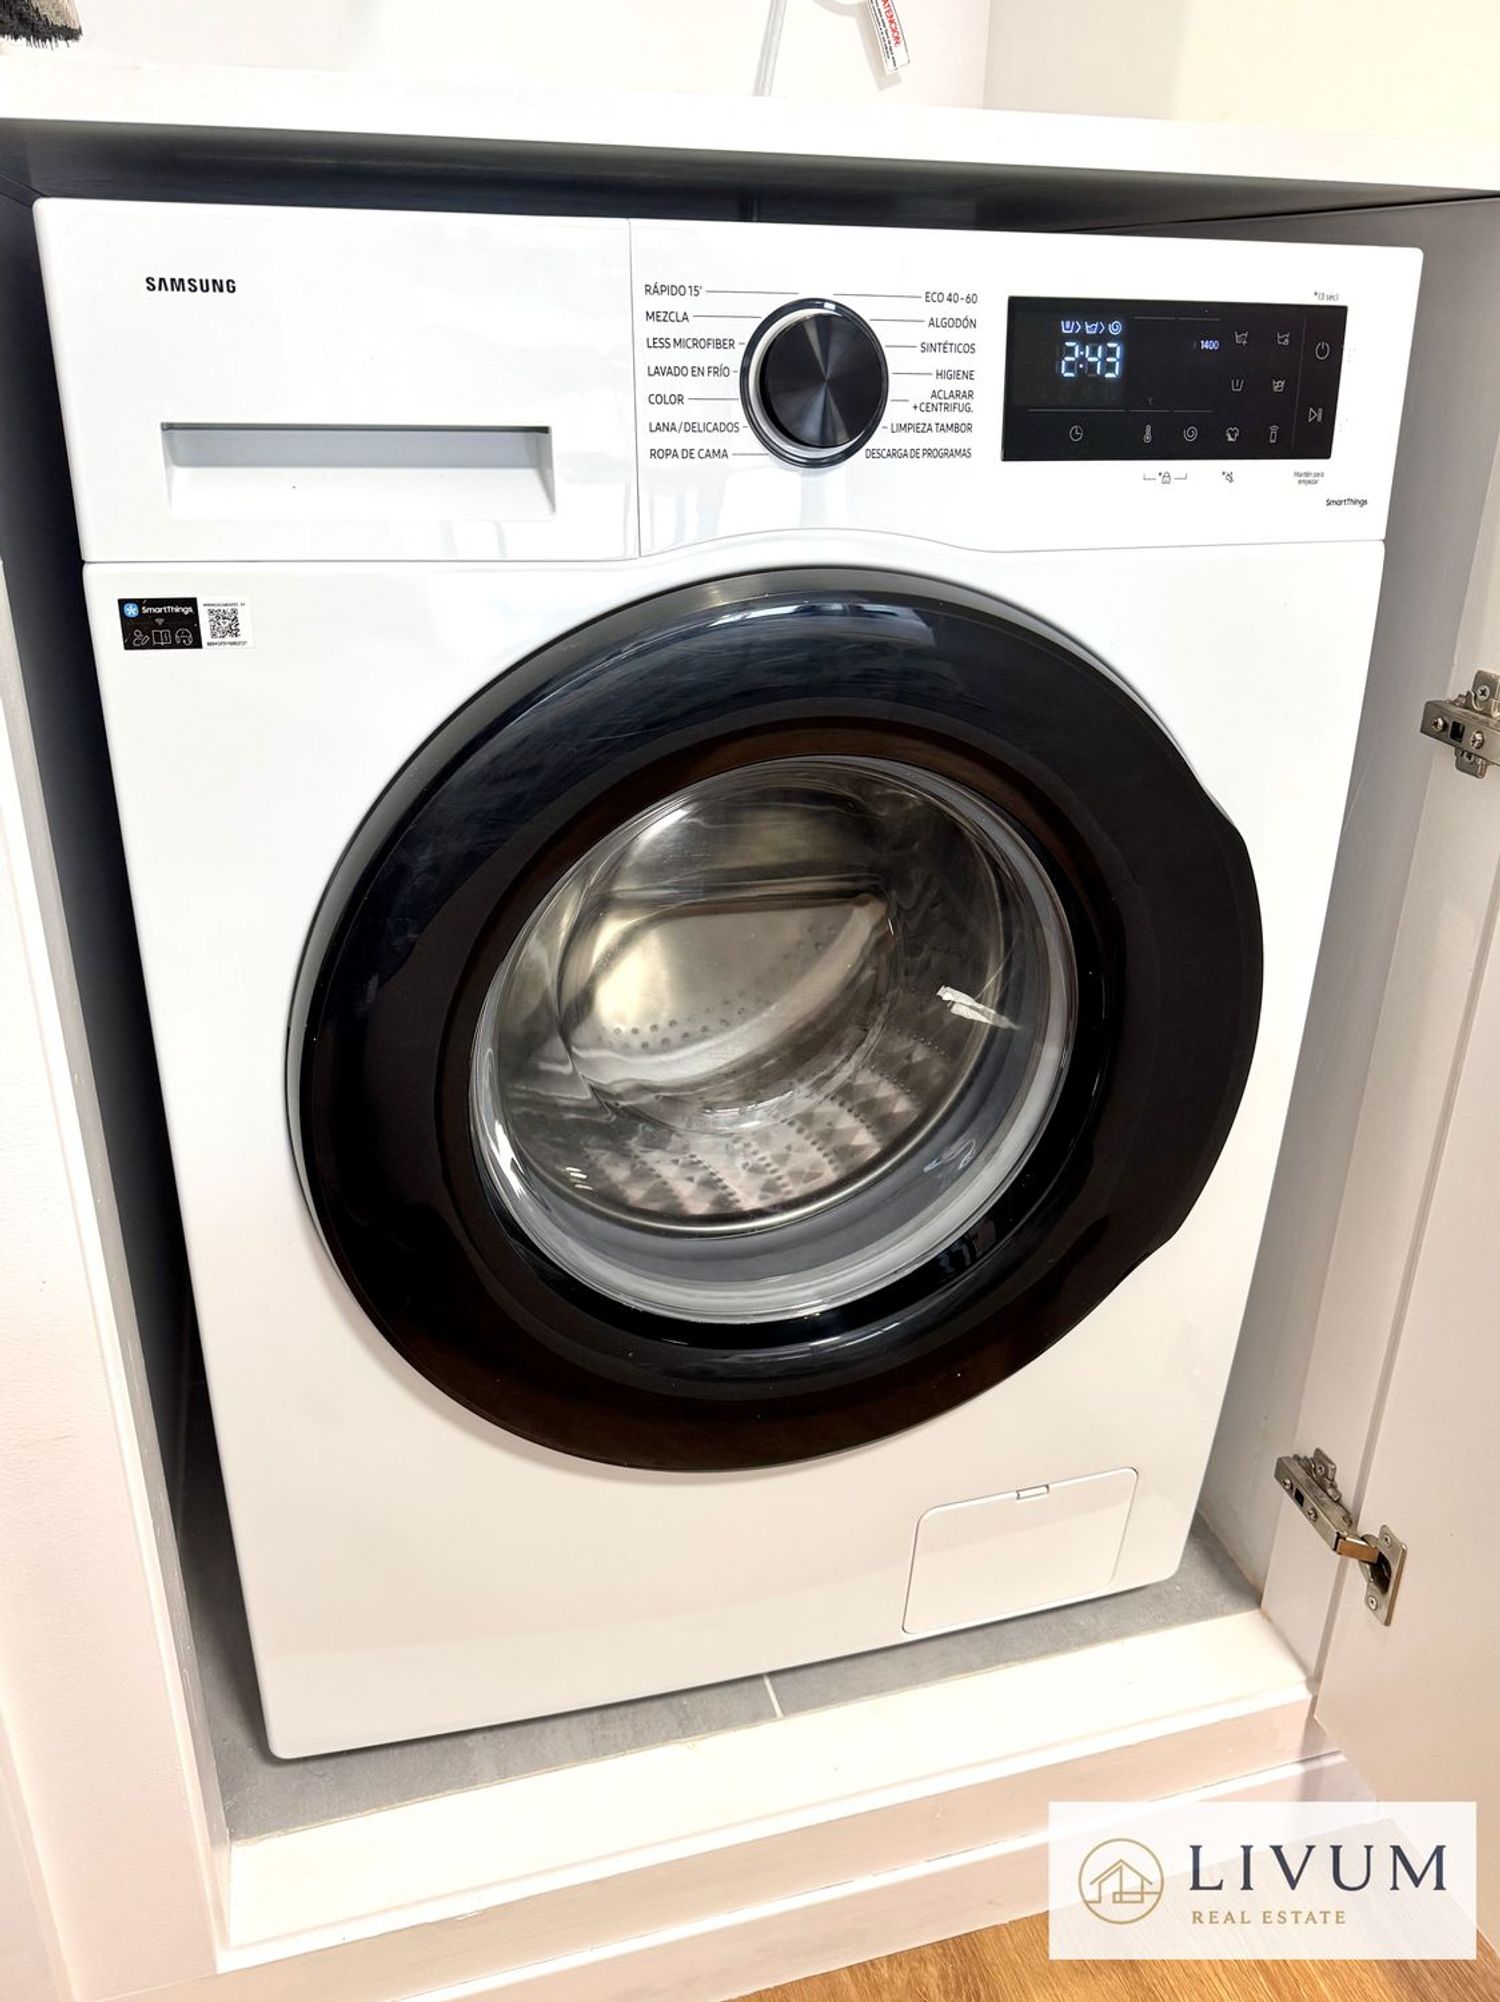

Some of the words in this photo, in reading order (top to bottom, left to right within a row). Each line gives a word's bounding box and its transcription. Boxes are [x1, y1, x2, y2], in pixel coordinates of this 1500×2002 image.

[145, 277, 237, 293] SAMSUNG
[644, 282, 687, 297] RÁPIDO
[687, 284, 703, 297] 15'
[925, 291, 945, 304] ECO
[645, 311, 690, 323] MEZCLA
[928, 315, 977, 329] ALGODÓN
[646, 337, 671, 349] LESS
[673, 338, 735, 350] MICROFIBER
[920, 340, 976, 354] SINTÉTICOS
[1200, 340, 1220, 350] 1400
[1060, 341, 1121, 378] 2:43
[647, 365, 689, 378] LAVADO
[691, 366, 705, 377] EN
[707, 363, 730, 378] FRÍO
[935, 369, 976, 381] HIGIENE
[648, 393, 685, 405] COLOR
[930, 389, 975, 400] ACLARAR
[890, 422, 933, 434] LIMPIEZA
[935, 423, 973, 434] TAMBOR
[649, 448, 680, 460] ROPA
[681, 449, 694, 460] DE
[697, 449, 729, 460] CAMA
[865, 448, 908, 459] DESCARGA
[909, 448, 921, 459] DE
[922, 448, 972, 459] PROGRAMAS
[1326, 498, 1368, 508] SmartThings
[141, 605, 193, 615] SmartThings
